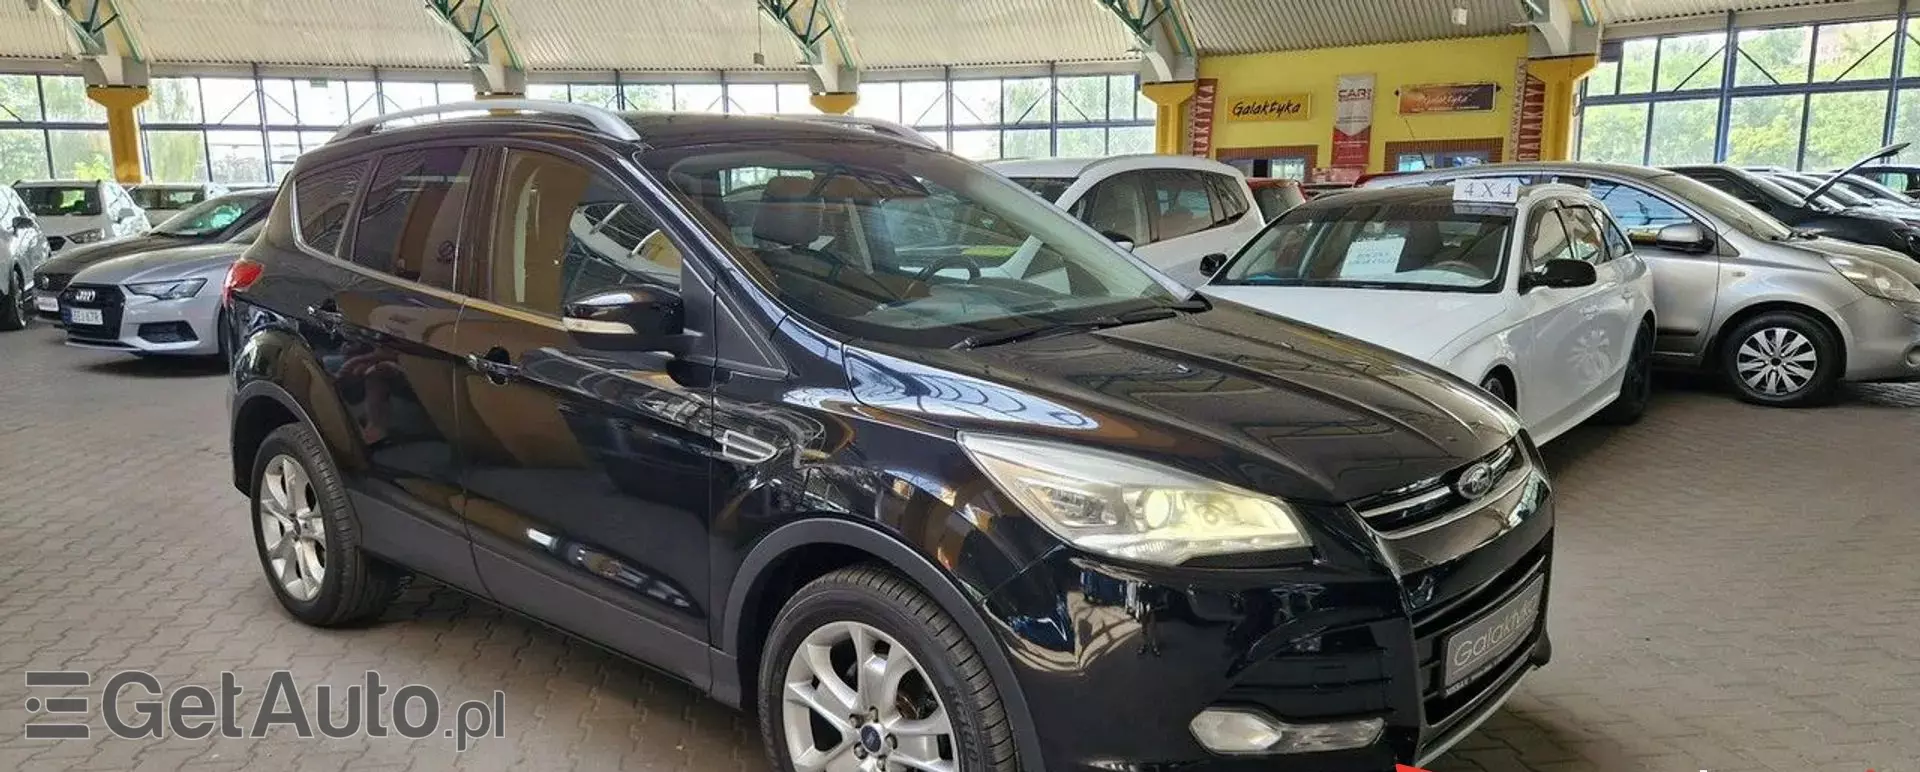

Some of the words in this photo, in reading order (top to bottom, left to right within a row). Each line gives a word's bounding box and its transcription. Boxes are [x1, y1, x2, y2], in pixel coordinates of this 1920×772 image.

[1232, 100, 1301, 117] Galaktyka
[1464, 182, 1474, 197] 4
[1501, 182, 1512, 198] 4
